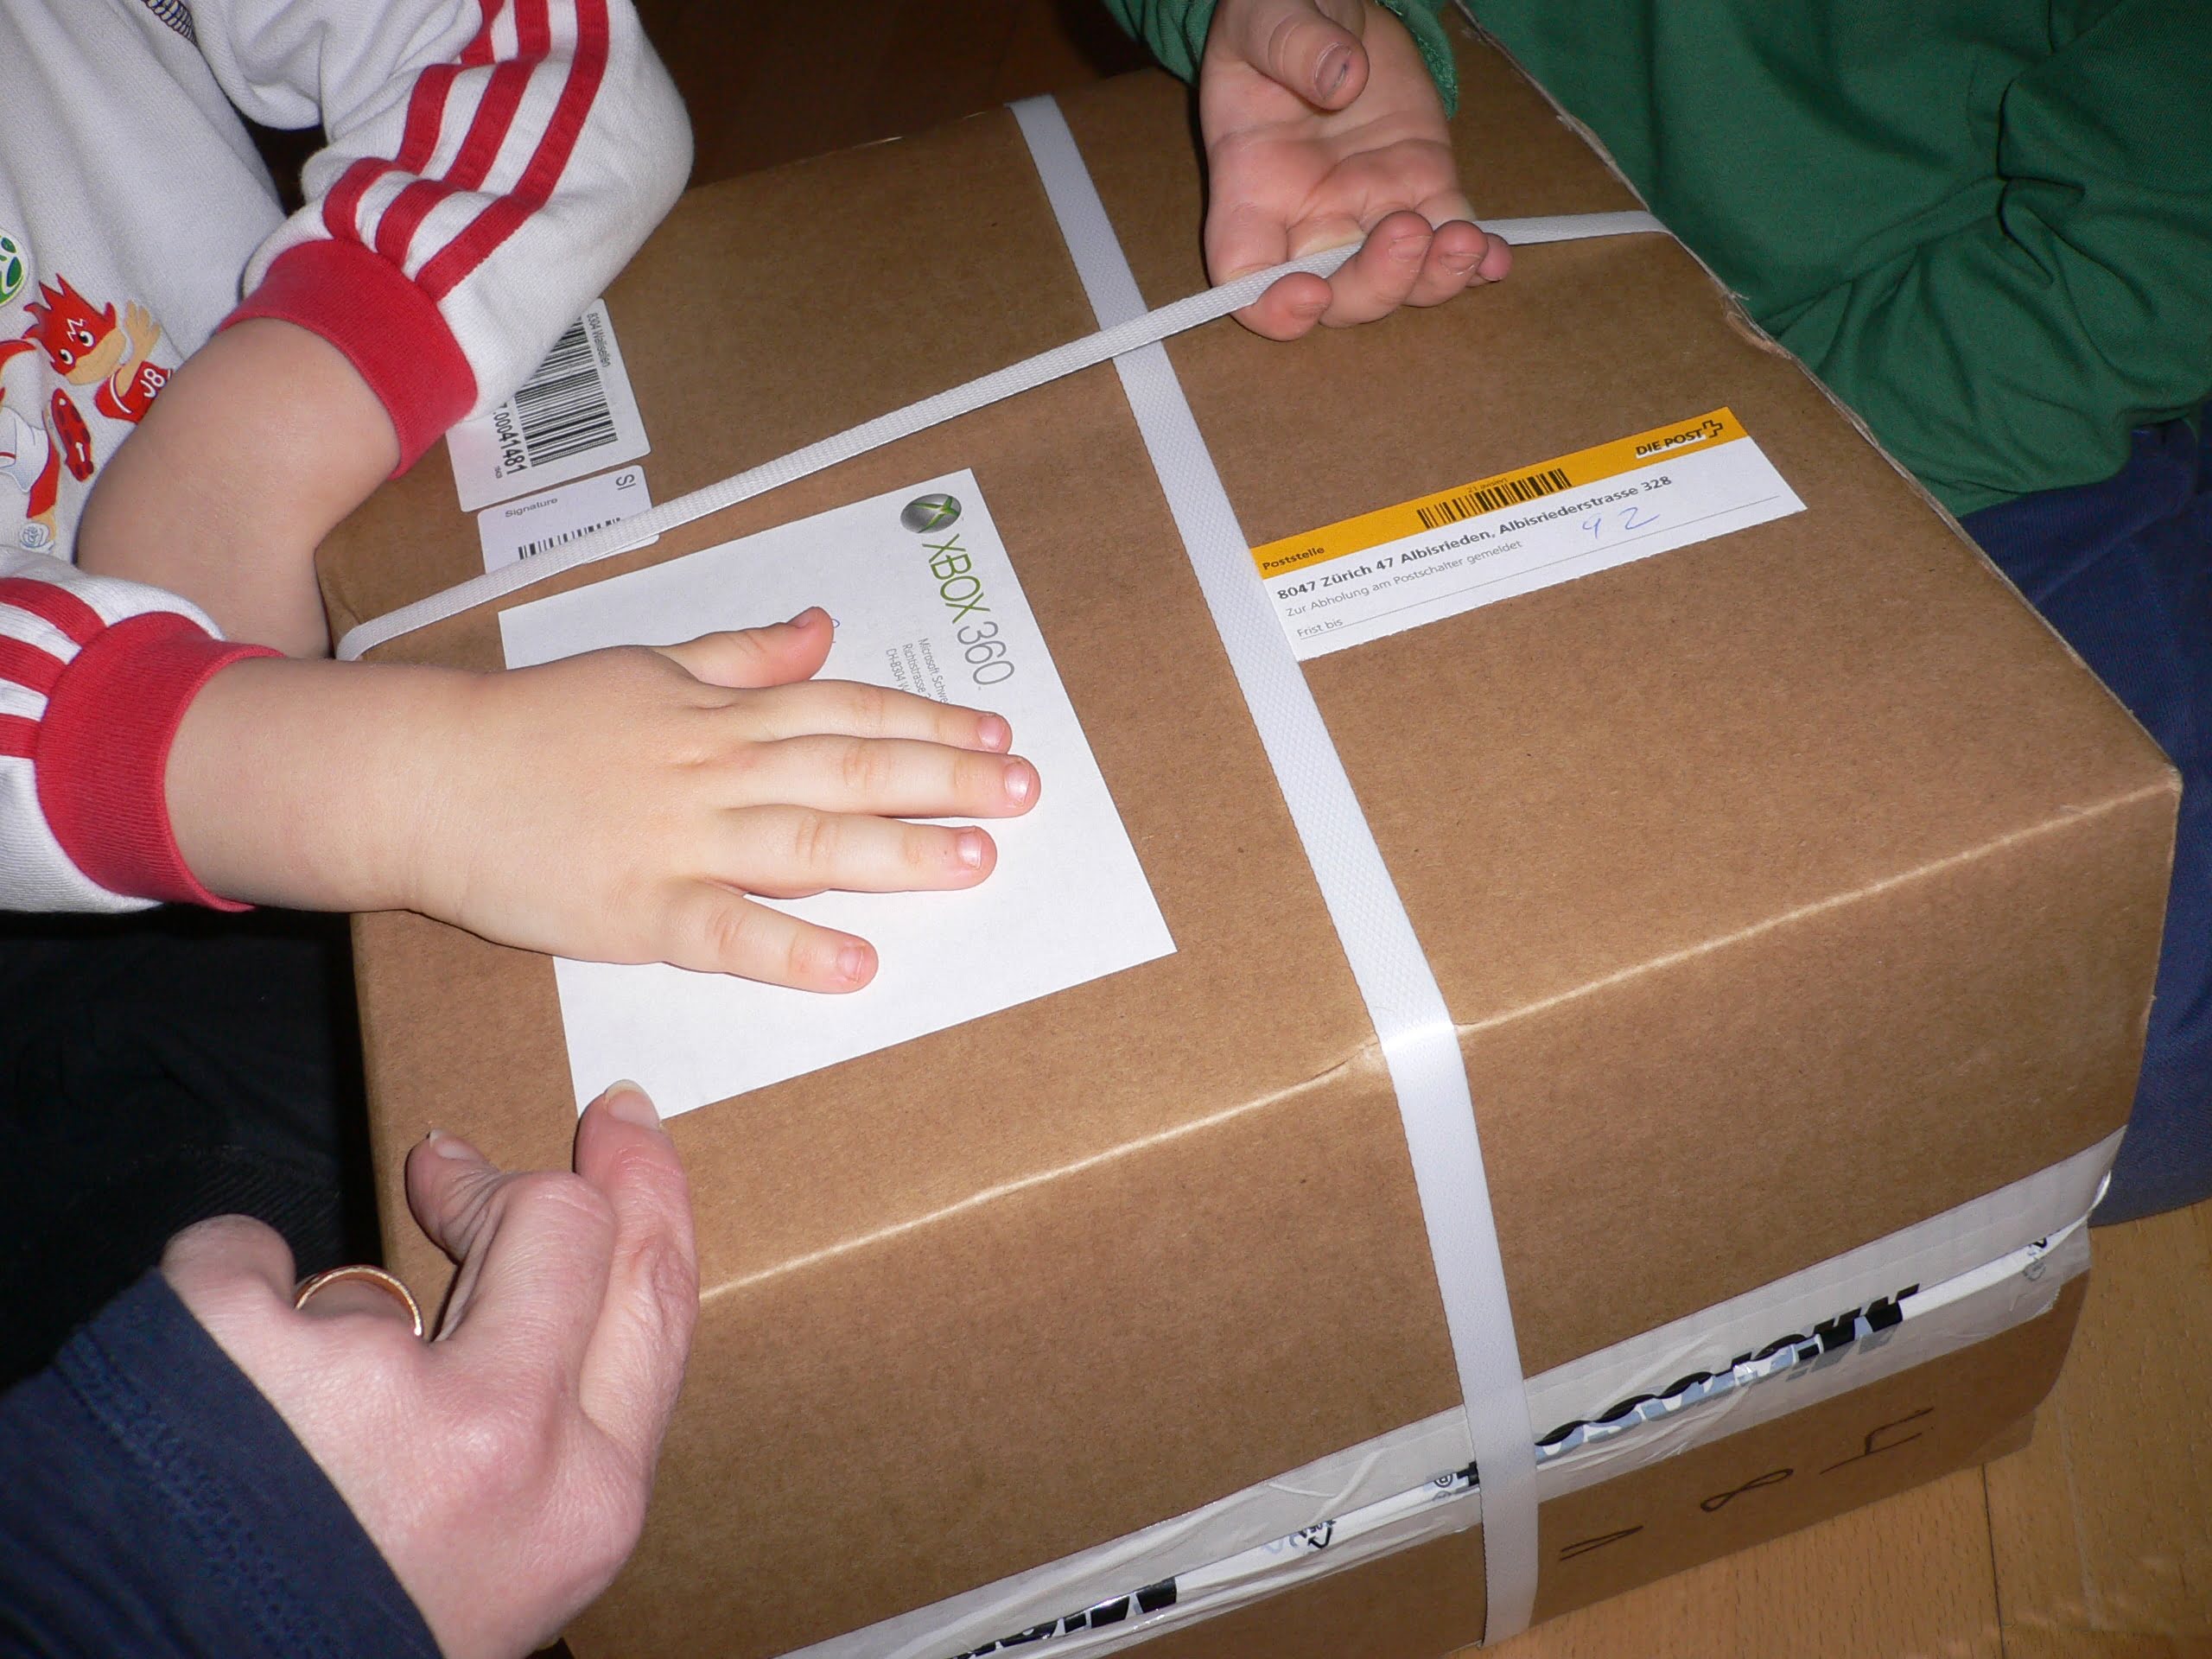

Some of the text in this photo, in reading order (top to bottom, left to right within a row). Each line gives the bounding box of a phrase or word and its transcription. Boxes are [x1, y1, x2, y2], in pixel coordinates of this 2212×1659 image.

[1635, 429, 1705, 456] DIE POST
[505, 496, 559, 518] Signature
[1277, 475, 1673, 601] 8047 Zürich 47 Albisrieden, Albisriederstrasse 328
[1262, 546, 1325, 571] Poststelle
[1287, 540, 1523, 618] Zur Abholung am Postschalter gemeldet
[922, 533, 1015, 686] XBOX 360
[1297, 617, 1344, 638] Frist bis
[931, 674, 950, 704] Schwe
